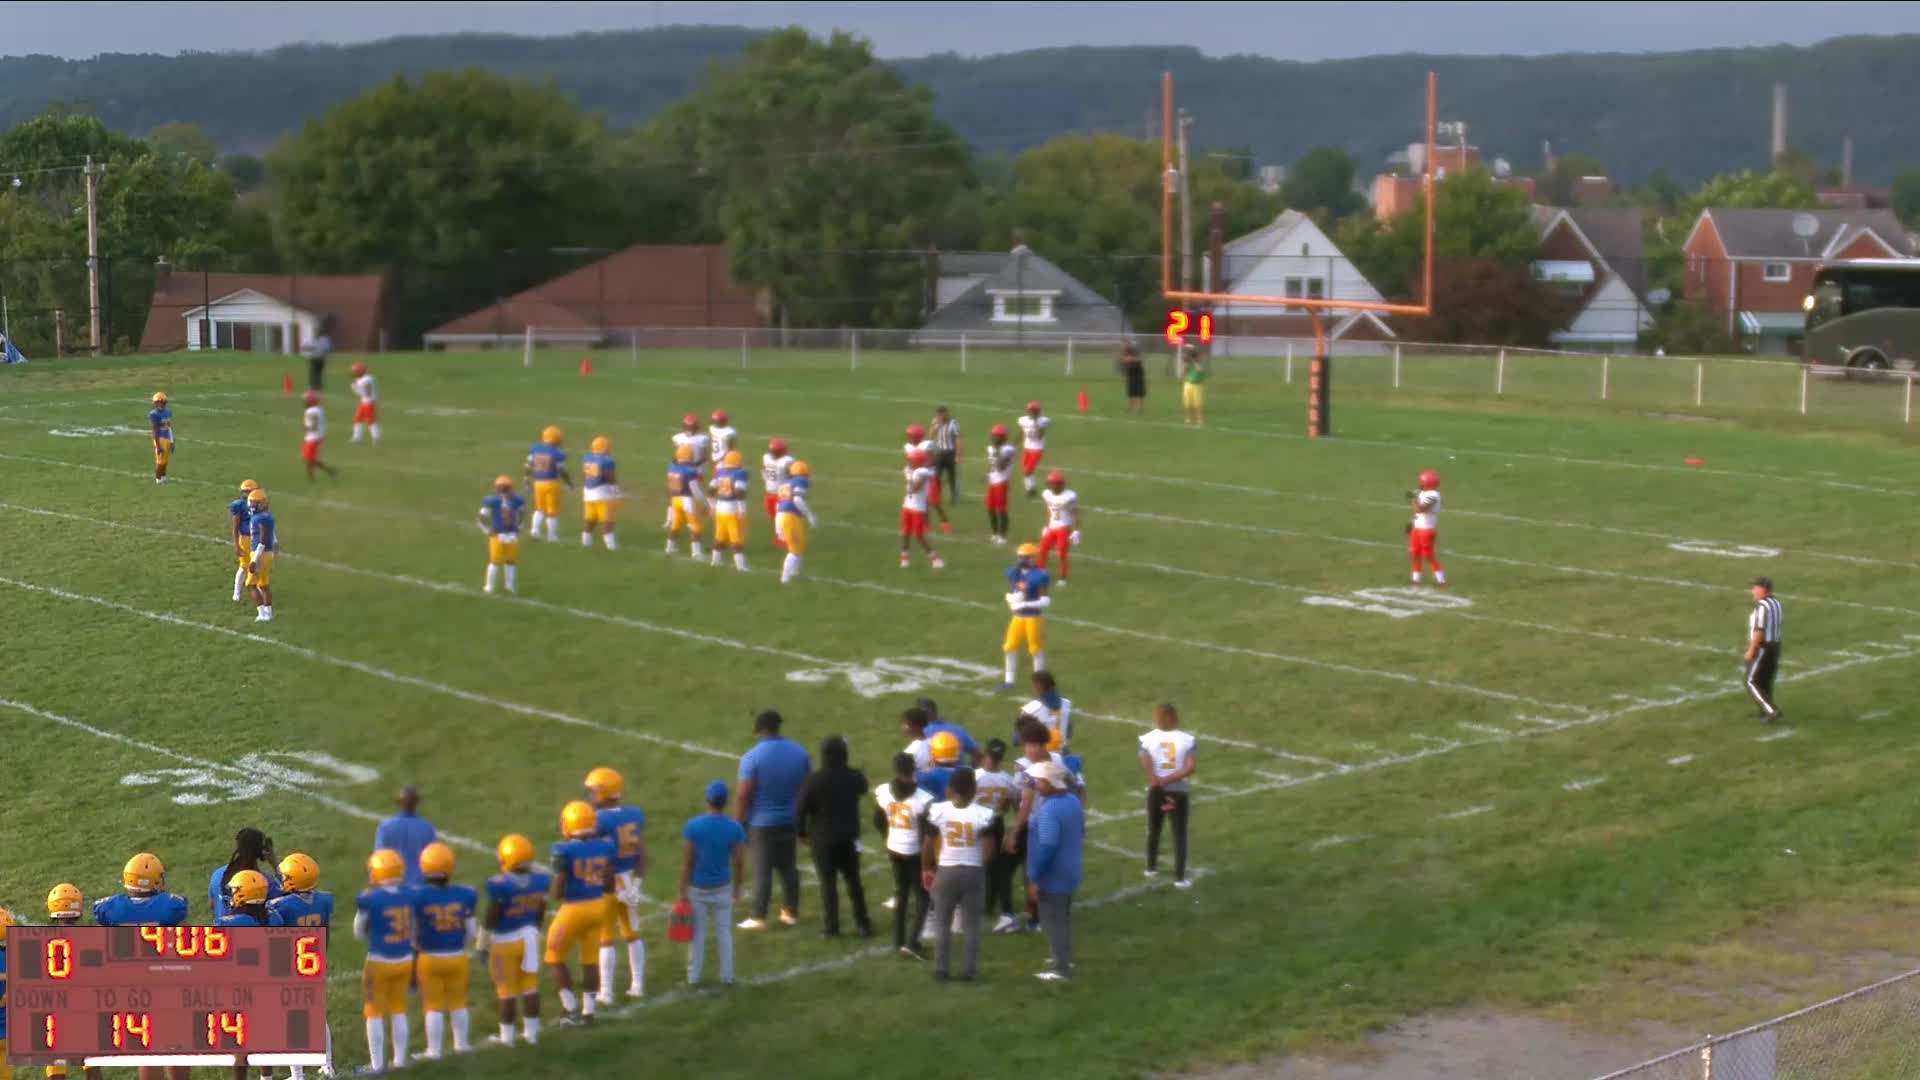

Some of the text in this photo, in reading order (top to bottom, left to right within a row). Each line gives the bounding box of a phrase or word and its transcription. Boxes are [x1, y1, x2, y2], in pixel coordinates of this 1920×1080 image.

[1167, 310, 1212, 344] 21
[1160, 741, 1177, 769] 3
[946, 821, 975, 848] 21
[383, 905, 411, 944] 31
